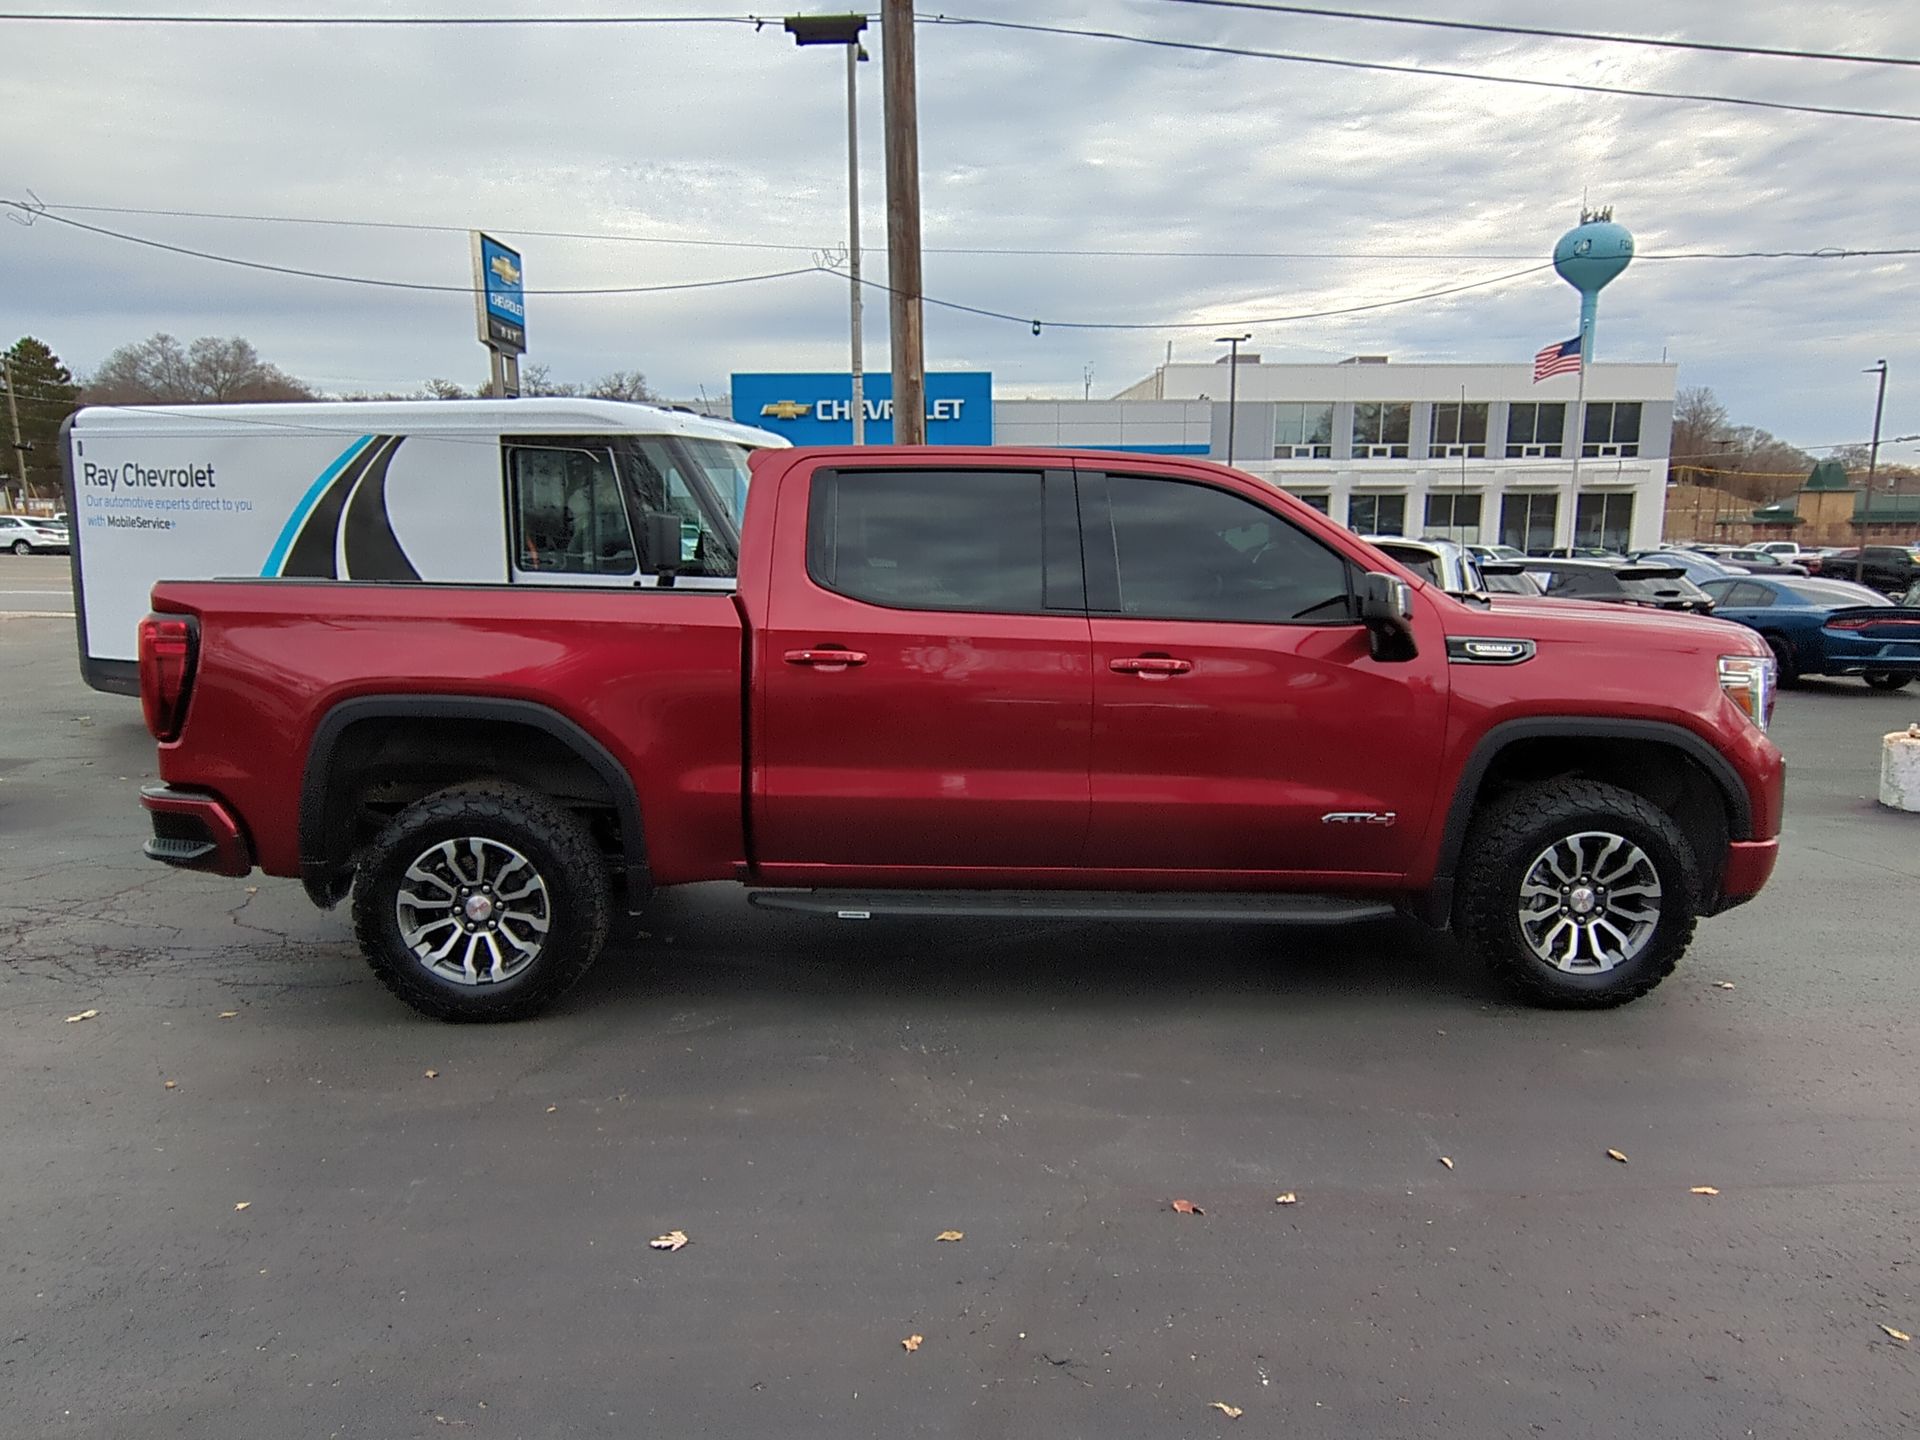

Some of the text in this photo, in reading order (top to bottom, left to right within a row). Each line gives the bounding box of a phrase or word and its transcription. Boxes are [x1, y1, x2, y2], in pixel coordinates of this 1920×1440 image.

[490, 292, 523, 317] CHEVROLET
[816, 398, 965, 421] CHVRET
[84, 462, 216, 492] Ray Chevrolet
[86, 494, 253, 513] Our automotive experts direct to you
[87, 515, 106, 527] with
